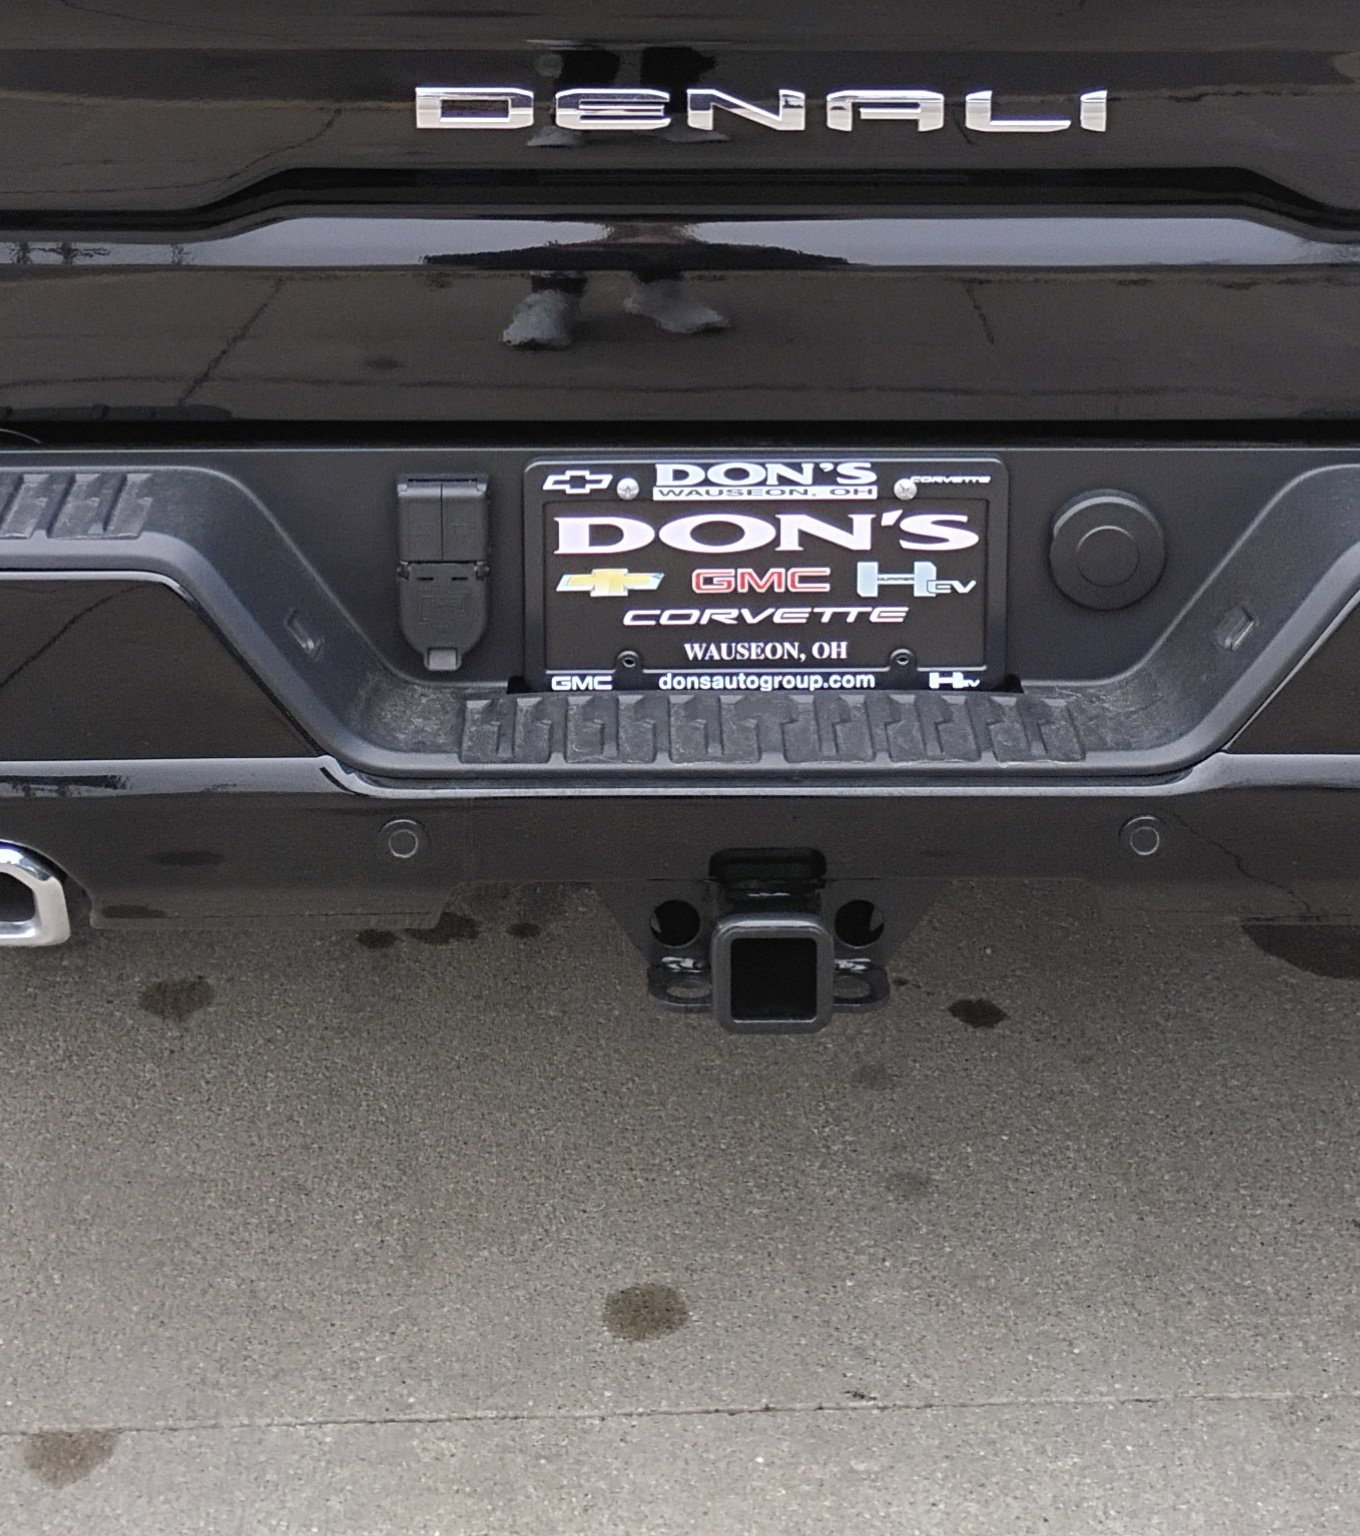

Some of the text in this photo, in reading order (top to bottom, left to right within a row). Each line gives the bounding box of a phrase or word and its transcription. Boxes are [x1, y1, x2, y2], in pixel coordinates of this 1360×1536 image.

[415, 87, 1108, 133] DENALI
[654, 462, 878, 487] DON'S
[829, 488, 874, 497] OH
[553, 509, 980, 555] DON'S
[691, 567, 831, 594] GMC
[623, 606, 909, 626] CORVETTE
[683, 641, 848, 662] WAUSEON, OH
[551, 675, 613, 691] GMC
[658, 672, 876, 692] donsautogroup.com
